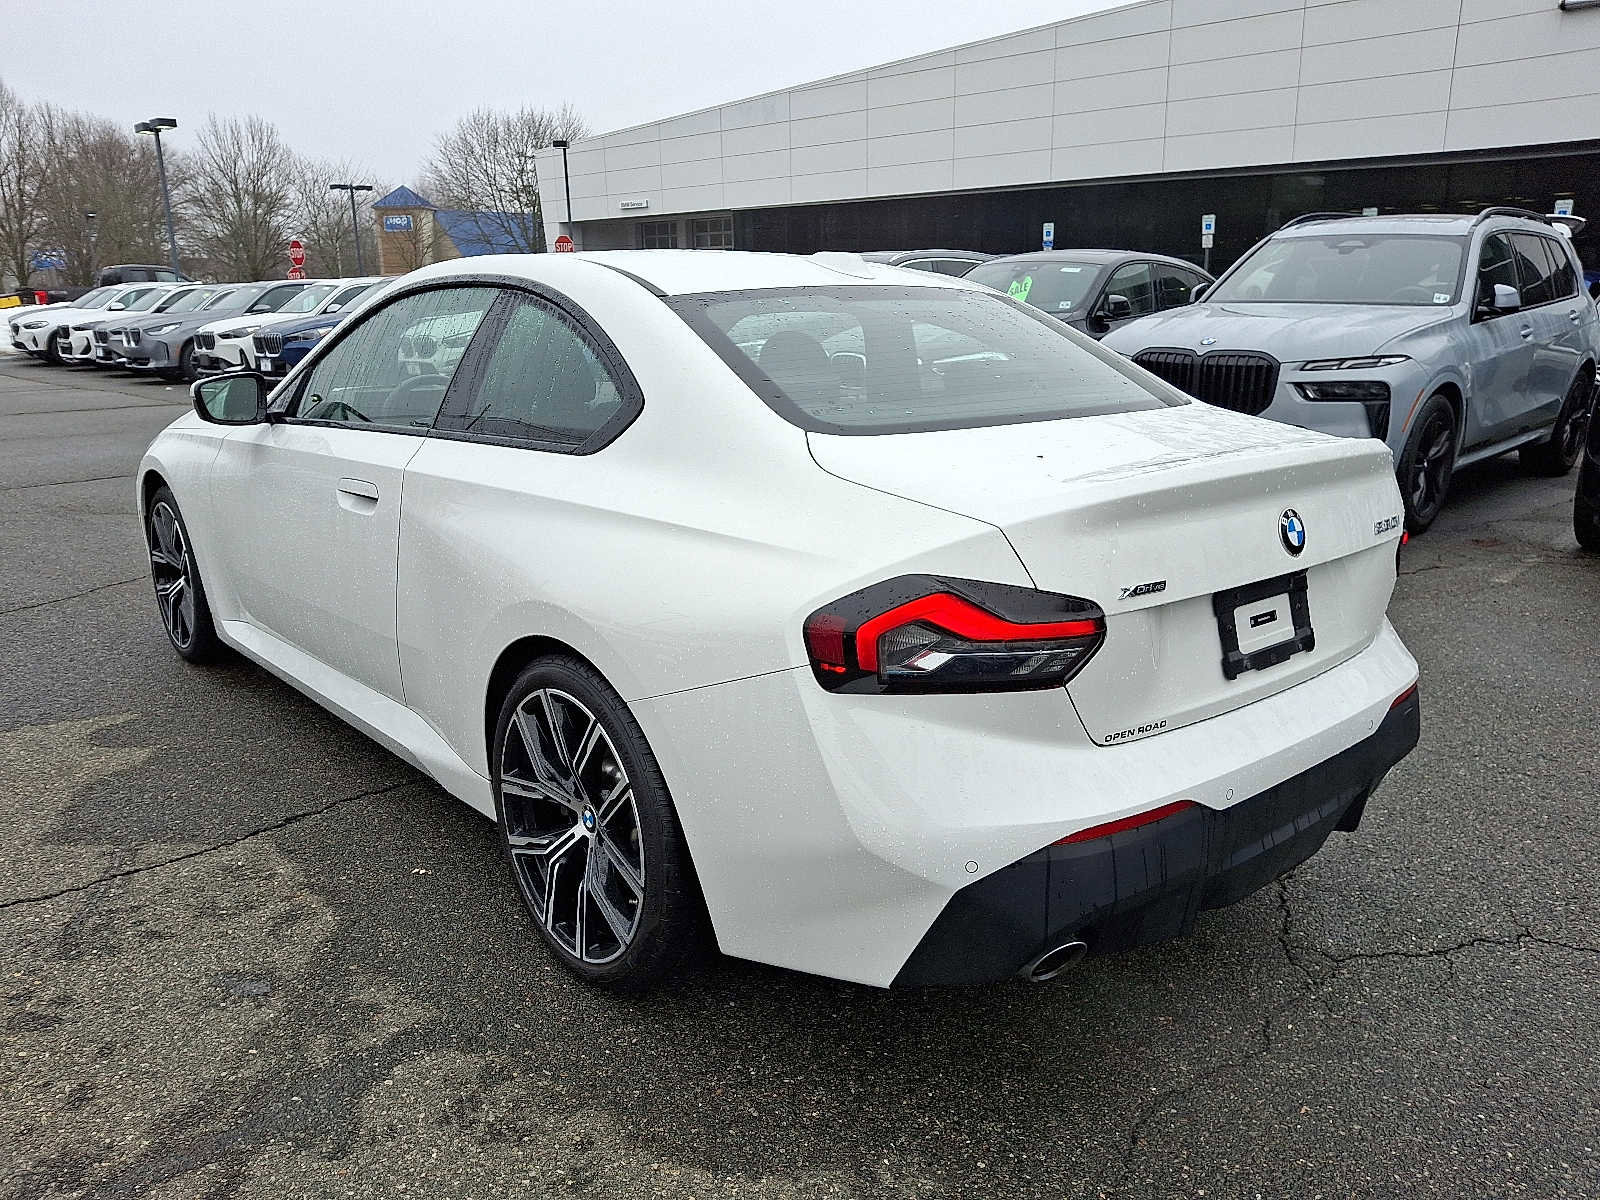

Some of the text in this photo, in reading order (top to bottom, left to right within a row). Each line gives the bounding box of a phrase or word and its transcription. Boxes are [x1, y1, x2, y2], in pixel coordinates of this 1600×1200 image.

[290, 247, 303, 258] STOP
[556, 243, 572, 252] STOP
[1009, 281, 1029, 296] SALE
[1104, 719, 1167, 742] OPEN ROAD
